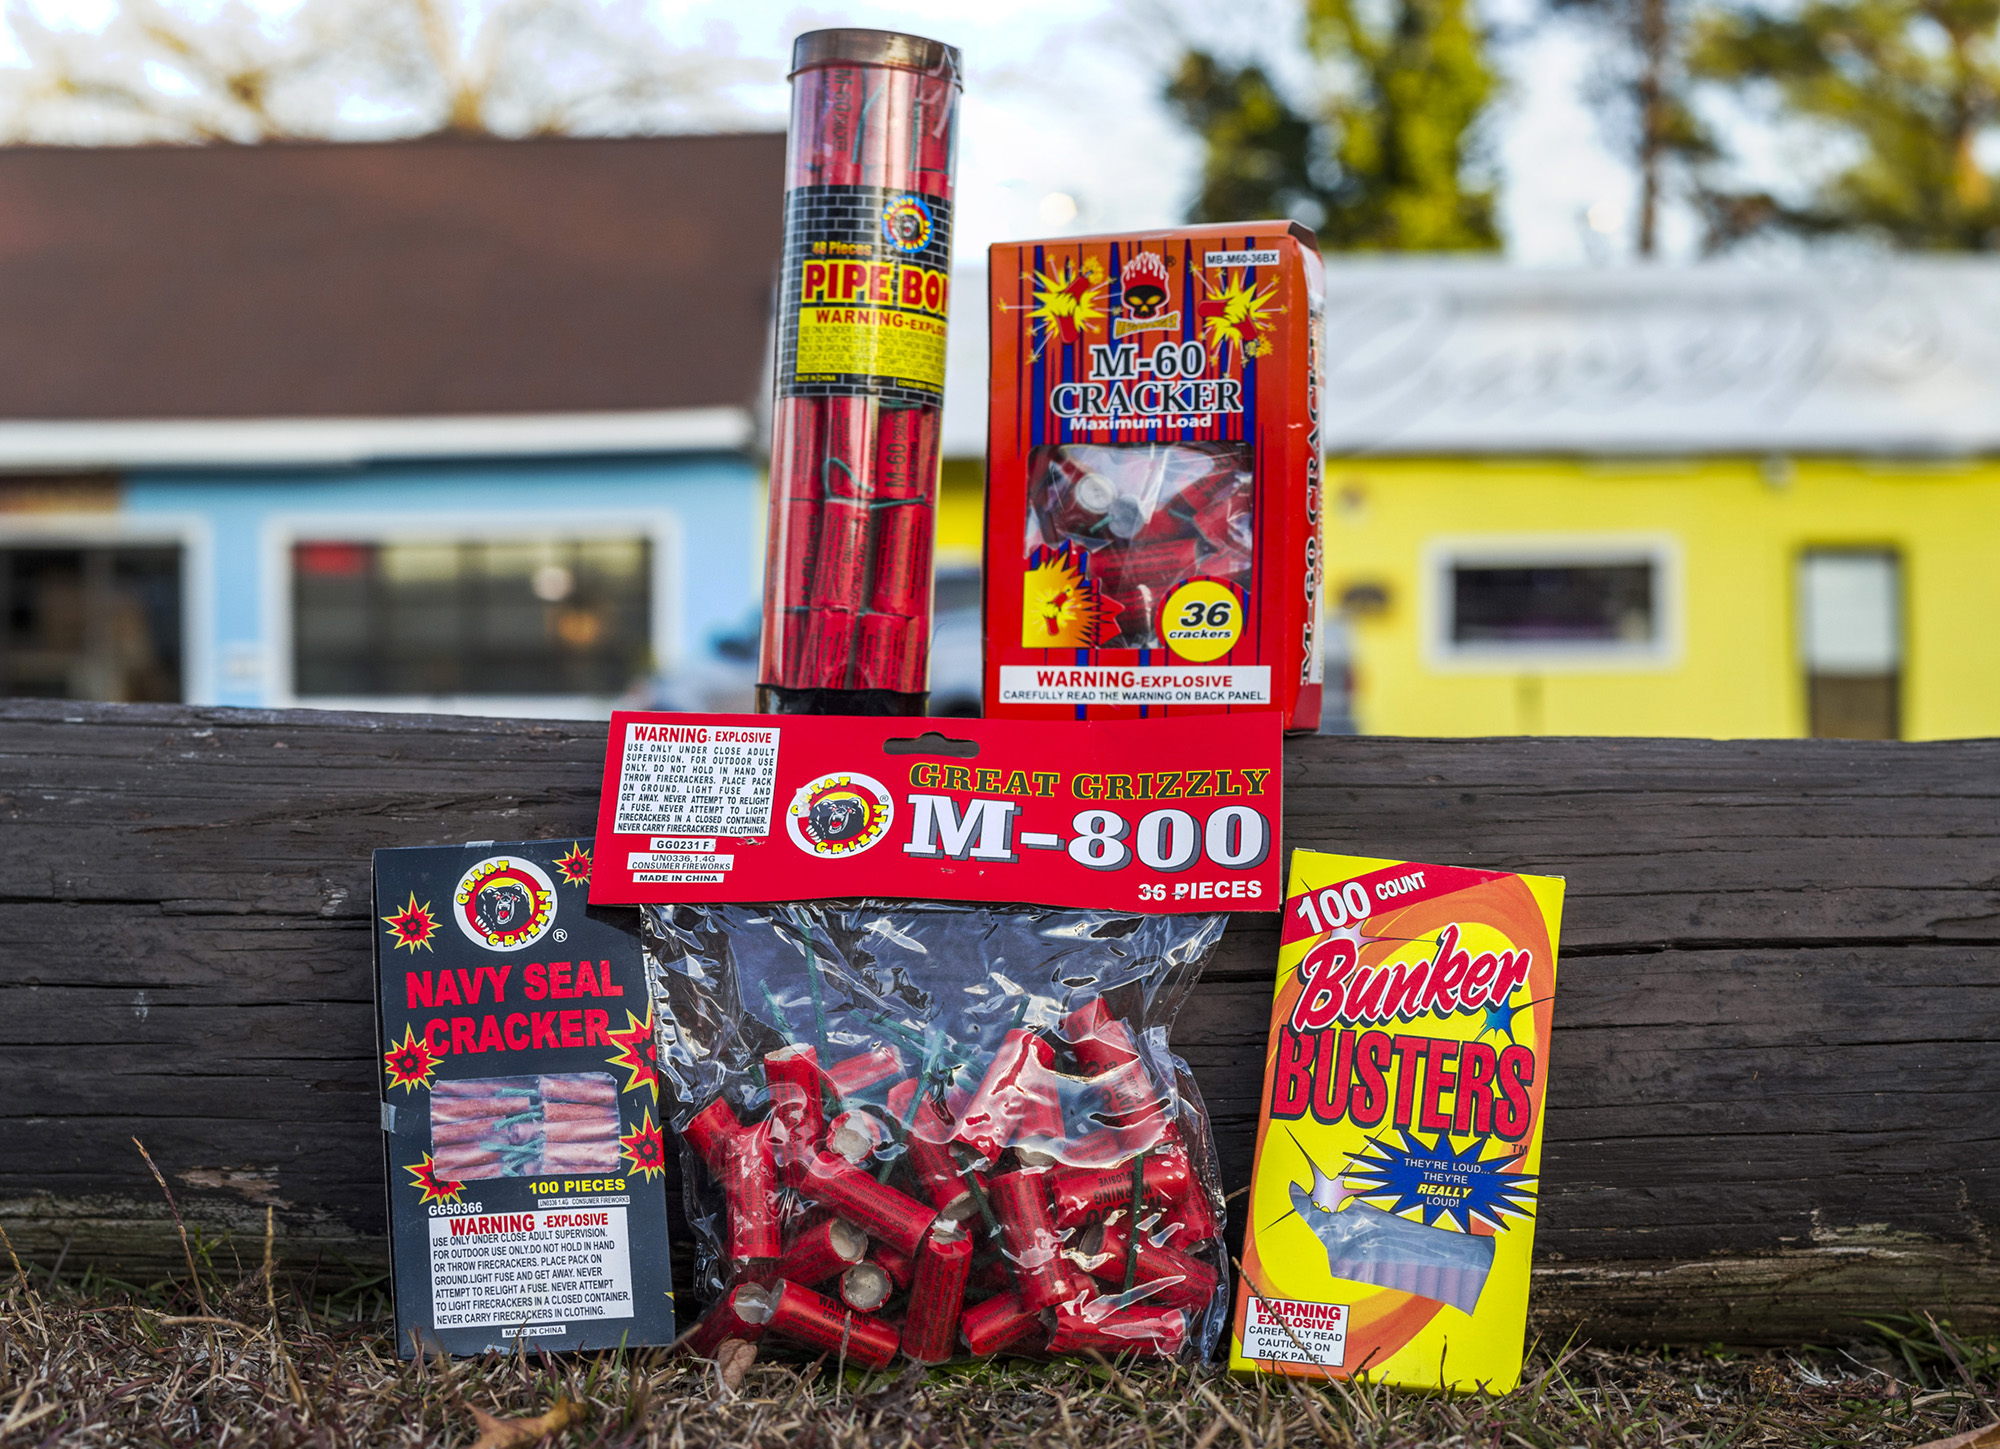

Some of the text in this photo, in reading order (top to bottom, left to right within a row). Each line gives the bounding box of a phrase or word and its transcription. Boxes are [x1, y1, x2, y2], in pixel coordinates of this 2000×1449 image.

[829, 241, 872, 256] Pieces
[1208, 253, 1277, 264] MB-M60-36BX
[801, 259, 895, 305] PIPE
[1089, 341, 1206, 380] M-60
[1051, 380, 1244, 417] CRACKER
[1070, 414, 1212, 431] Maximum Load
[1180, 601, 1231, 627] 36
[1168, 629, 1231, 639] crackers
[1004, 691, 1266, 700] CAREFULLY READ THE WARNING ON BACK PANEL.
[714, 731, 772, 743] EXPLOSIVE
[626, 743, 774, 756] USE ONLY UNDER CLOSE ADULT
[625, 753, 773, 765] SUPERVISION. FOR OUTDOOR USE
[624, 763, 772, 775] ONLY. DO NOT HOLD IN HAND OR
[623, 773, 771, 785] THROW FIRECRACKERS. PLACE PACK
[909, 762, 1270, 801] GREAT GRIZZLY
[622, 783, 770, 795] ON GROUND. LIGHT FUSE AND
[620, 793, 769, 805] GET AWAY. NEVER ATTEMPT TO RELIGHT
[630, 803, 768, 814] FUSE. NEVER ATTEMPT TO LIGHT
[618, 813, 767, 824] FIRECRACKERS IN CLOSED CONTAINER.
[617, 823, 766, 834] NEVER CARRY FIRECRACKERS IN CLOTHING.
[814, 804, 889, 854] GRIZZLY
[902, 793, 1270, 872] M-800
[657, 840, 709, 849] GG0231 F
[457, 860, 509, 906] GREAT
[1138, 880, 1262, 901] 36 PIECES
[1296, 871, 1426, 934] 100 COUNT
[486, 890, 552, 947] GRIZZLY
[406, 960, 624, 1009] NAVY SEAL
[1292, 922, 1532, 1036] Bunker
[424, 1008, 613, 1056] CRACKER
[1270, 1024, 1535, 1141] BUSTERS
[1404, 1158, 1448, 1169] THEY'RE
[1424, 1172, 1468, 1184] THEY'RE
[529, 1179, 625, 1194] 100 PIECES
[1417, 1184, 1472, 1198] REALLY
[428, 1202, 483, 1216] GG50366
[1427, 1197, 1459, 1207] LOUD!
[449, 1214, 535, 1236] WARNING
[432, 1227, 607, 1246] USE ONLY UNDER CLOSE ADULT SUPERVISION.
[433, 1249, 449, 1259] FOR
[451, 1247, 489, 1258] OUTDOOR
[491, 1246, 506, 1256] USE
[543, 1243, 559, 1253] NOT
[560, 1242, 582, 1252] HOLD
[584, 1241, 591, 1251] IN
[593, 1240, 614, 1250] HAND
[434, 1254, 601, 1272] OR THROW FIRECRACKERS. PLACE PACK ON
[494, 1271, 514, 1282] FUSE
[516, 1270, 533, 1280] AND
[534, 1269, 550, 1279] GET
[551, 1268, 575, 1278] AWAY.
[576, 1266, 602, 1277] NEVER
[435, 1279, 613, 1298] ATTEMPT TO RELIGHT FUSE. NEVER ATTEMPT
[436, 1291, 630, 1312] TO LIGHT FIRECRACKERS IN CLOSED CONTAINER.
[1255, 1299, 1341, 1320] WARNING
[436, 1305, 605, 1325] NEVER CARRY FIRECRACKERS IN CLOTHING.
[1249, 1326, 1342, 1341] CAREFULY READ
[1259, 1350, 1288, 1359] BACK
[1314, 1343, 1330, 1351] ON
